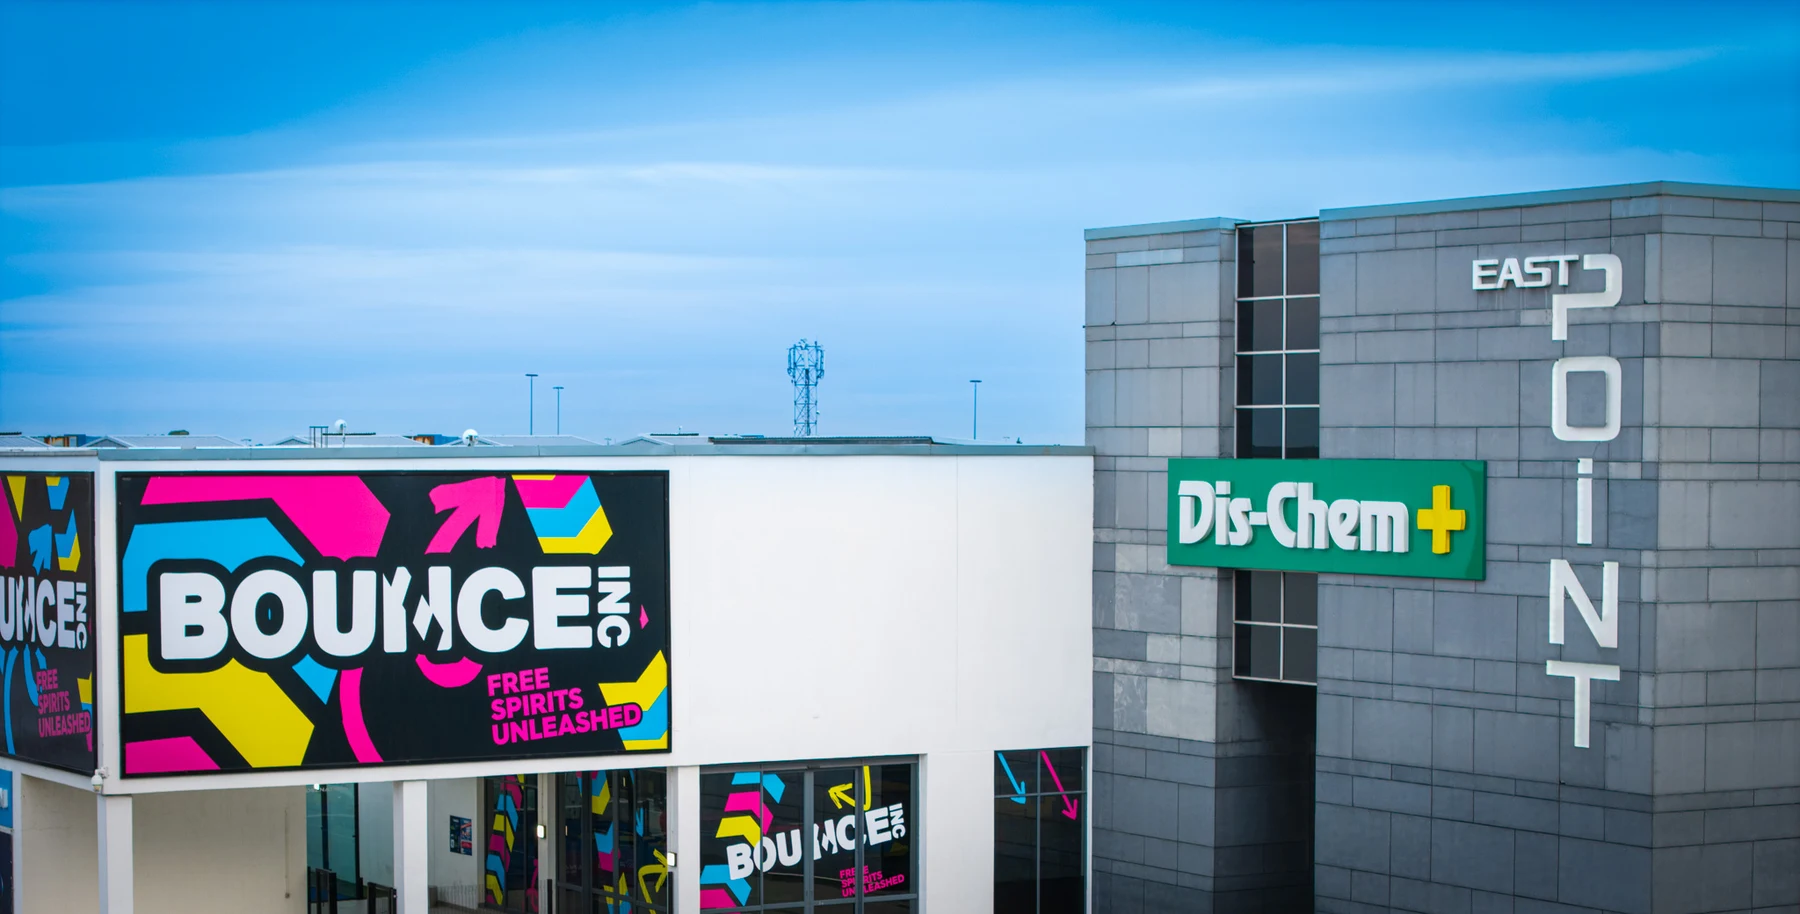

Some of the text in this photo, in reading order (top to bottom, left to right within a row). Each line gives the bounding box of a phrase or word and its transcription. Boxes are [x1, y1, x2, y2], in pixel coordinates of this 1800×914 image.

[1472, 254, 1580, 290] EAST
[1178, 481, 1410, 553] Dis-Chem
[75, 582, 87, 649] INC
[159, 566, 631, 660] BOUNCE INC
[36, 668, 58, 691] FREE
[487, 667, 550, 697] FREE
[38, 691, 70, 714] SPIRITS
[490, 687, 584, 721] SPIRITS
[38, 712, 91, 738] UNLEASHED
[491, 703, 643, 746] UNLEASHED
[726, 803, 906, 881] BOUNCE INC
